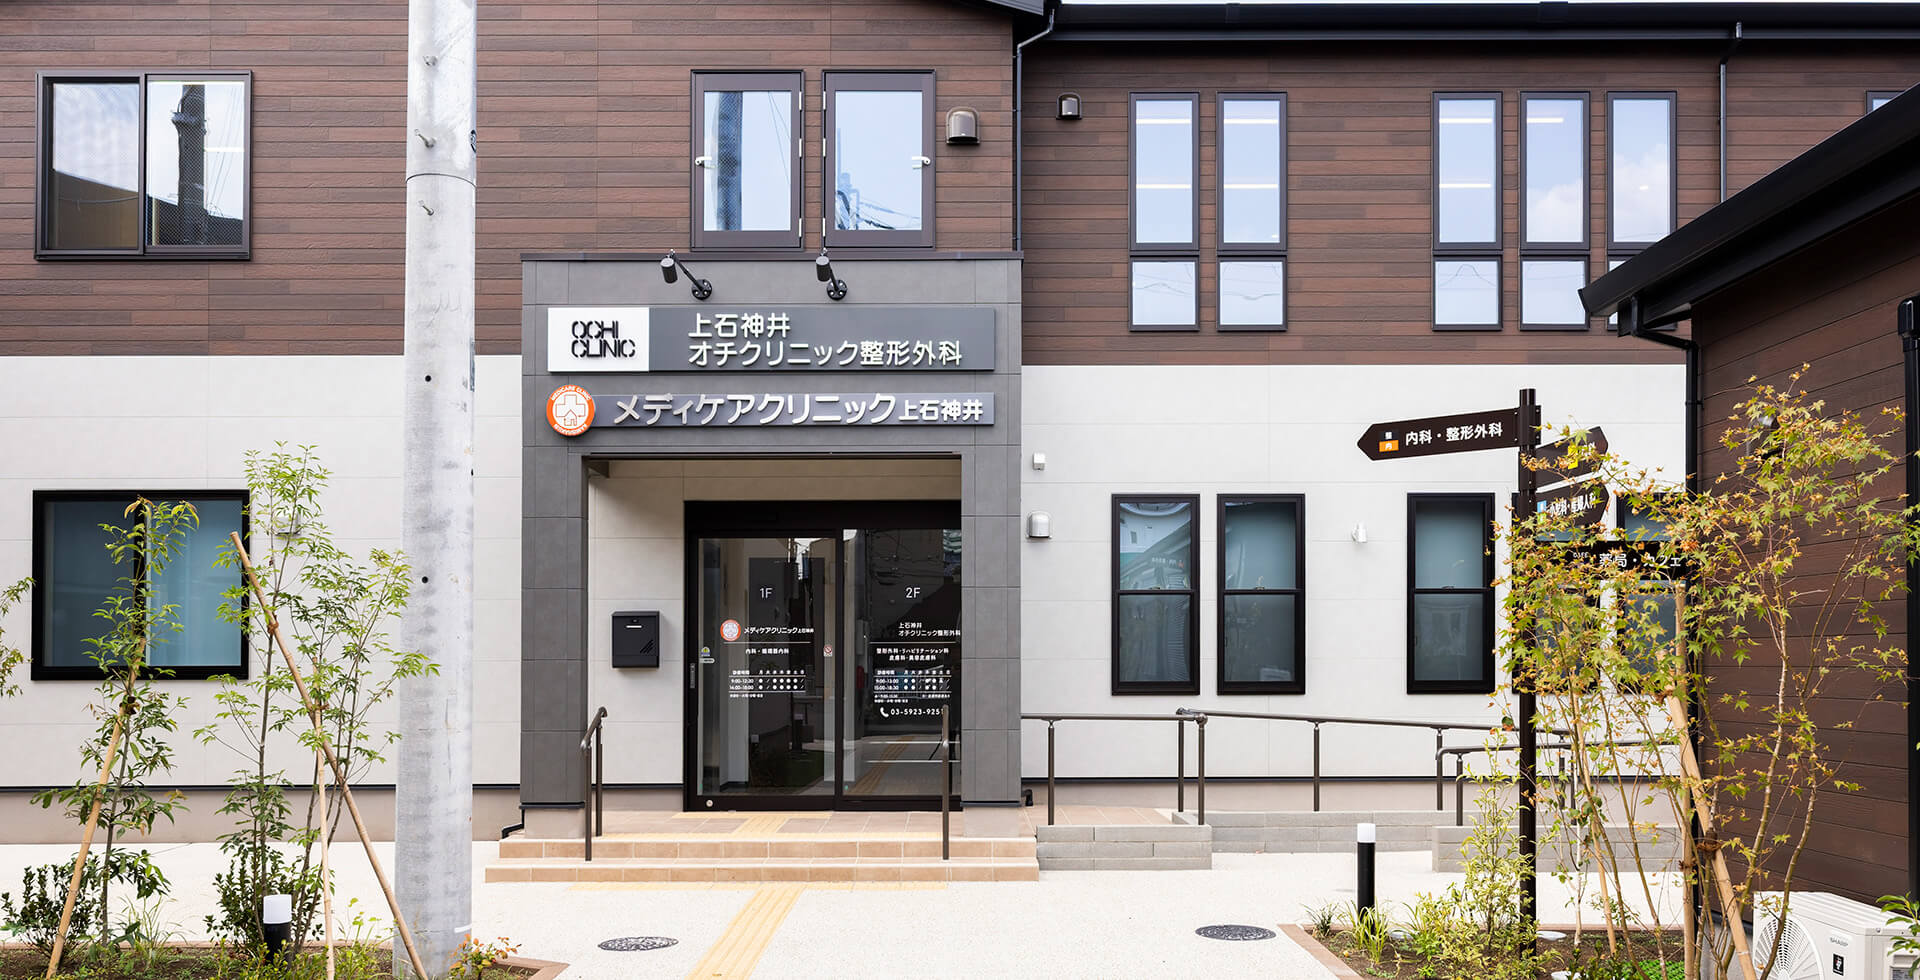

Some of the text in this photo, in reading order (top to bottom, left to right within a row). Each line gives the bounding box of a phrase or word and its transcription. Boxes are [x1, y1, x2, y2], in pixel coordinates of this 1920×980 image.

[571, 320, 620, 339] OCHI
[688, 312, 791, 338] 上石神井
[571, 339, 636, 359] CLINIC
[687, 339, 963, 367] オチクリニック整形外科
[1405, 421, 1503, 446] 内科・整形外科
[759, 587, 773, 599] 1F
[905, 587, 921, 599] 2F
